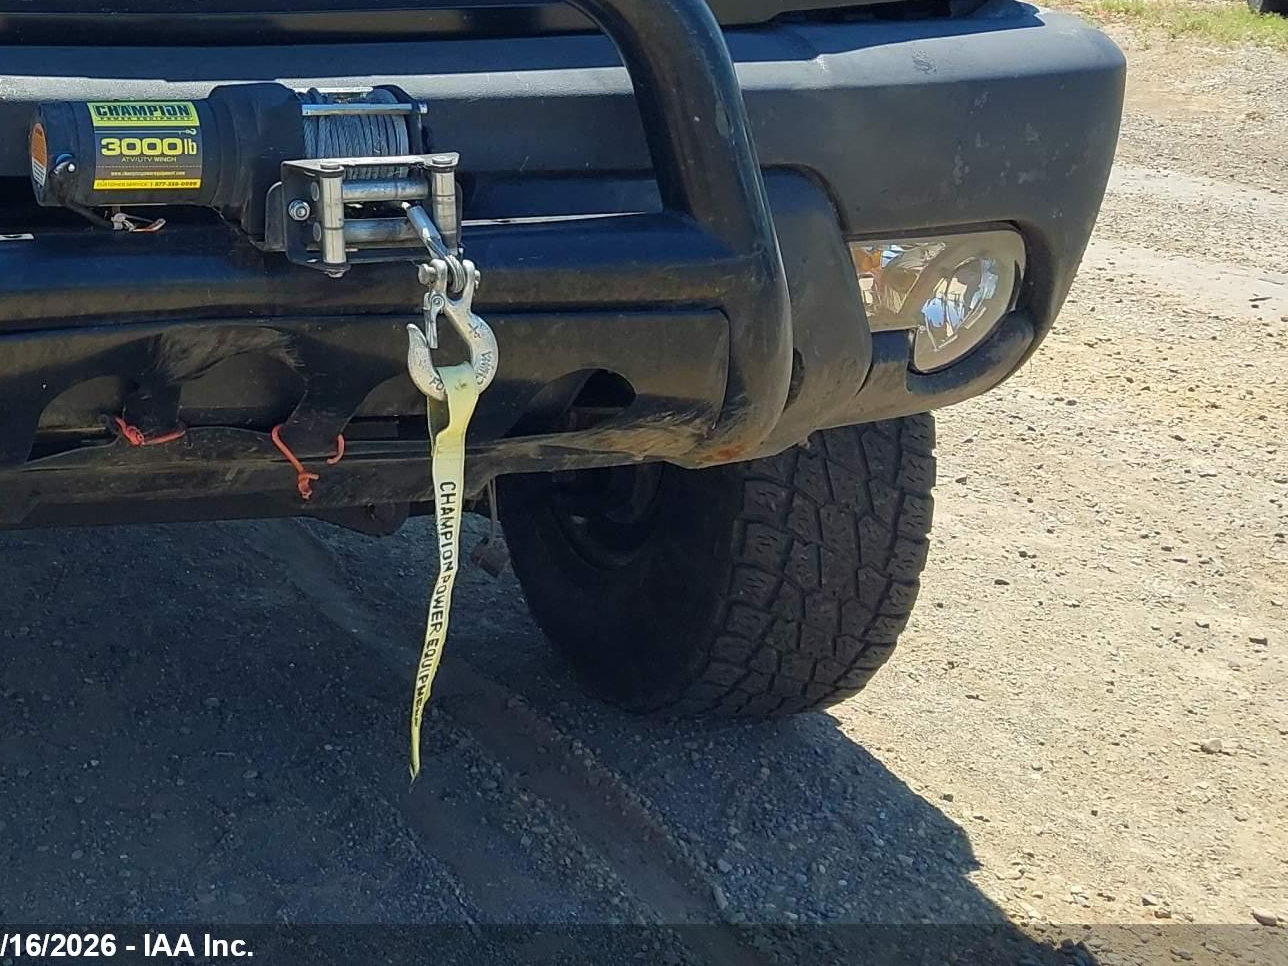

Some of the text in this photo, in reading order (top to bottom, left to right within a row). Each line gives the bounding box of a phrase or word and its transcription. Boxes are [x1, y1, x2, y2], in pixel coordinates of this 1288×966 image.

[95, 105, 191, 116] CHAMPION
[439, 481, 457, 572] CHAMPION
[429, 574, 451, 636] POWER
